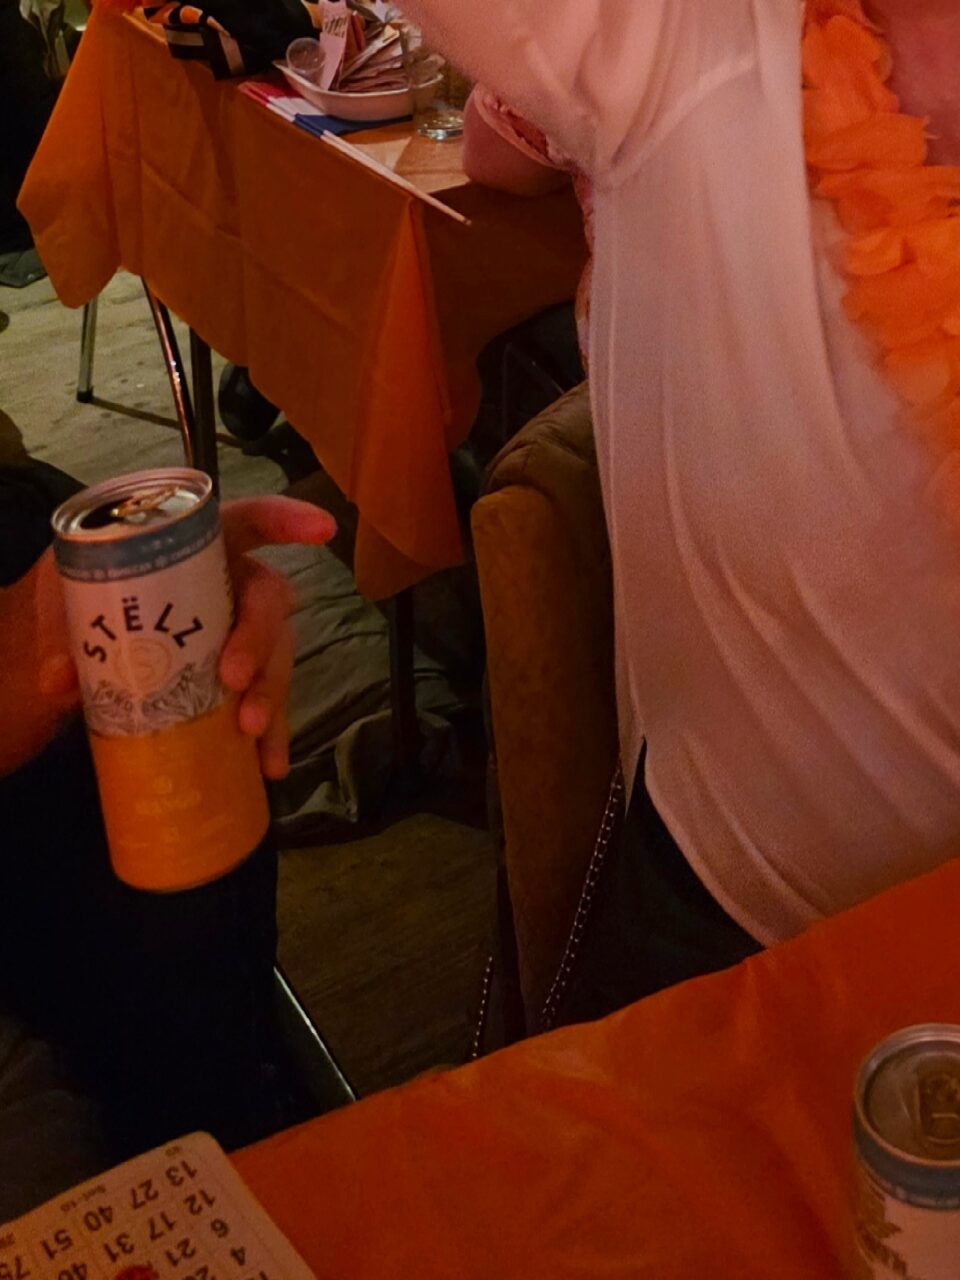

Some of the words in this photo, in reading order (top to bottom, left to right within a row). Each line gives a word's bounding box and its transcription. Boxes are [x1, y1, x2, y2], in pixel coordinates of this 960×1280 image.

[84, 596, 204, 664] STËLZ
[164, 1160, 199, 1187] 13
[129, 1178, 160, 1210] 27
[183, 1189, 217, 1217] 12
[83, 1205, 114, 1232] 40
[148, 1211, 177, 1242] 17
[209, 1218, 230, 1239] 6
[40, 1228, 74, 1260] 51
[103, 1231, 136, 1264] 31
[164, 1237, 198, 1268] 21
[229, 1245, 247, 1267] 4
